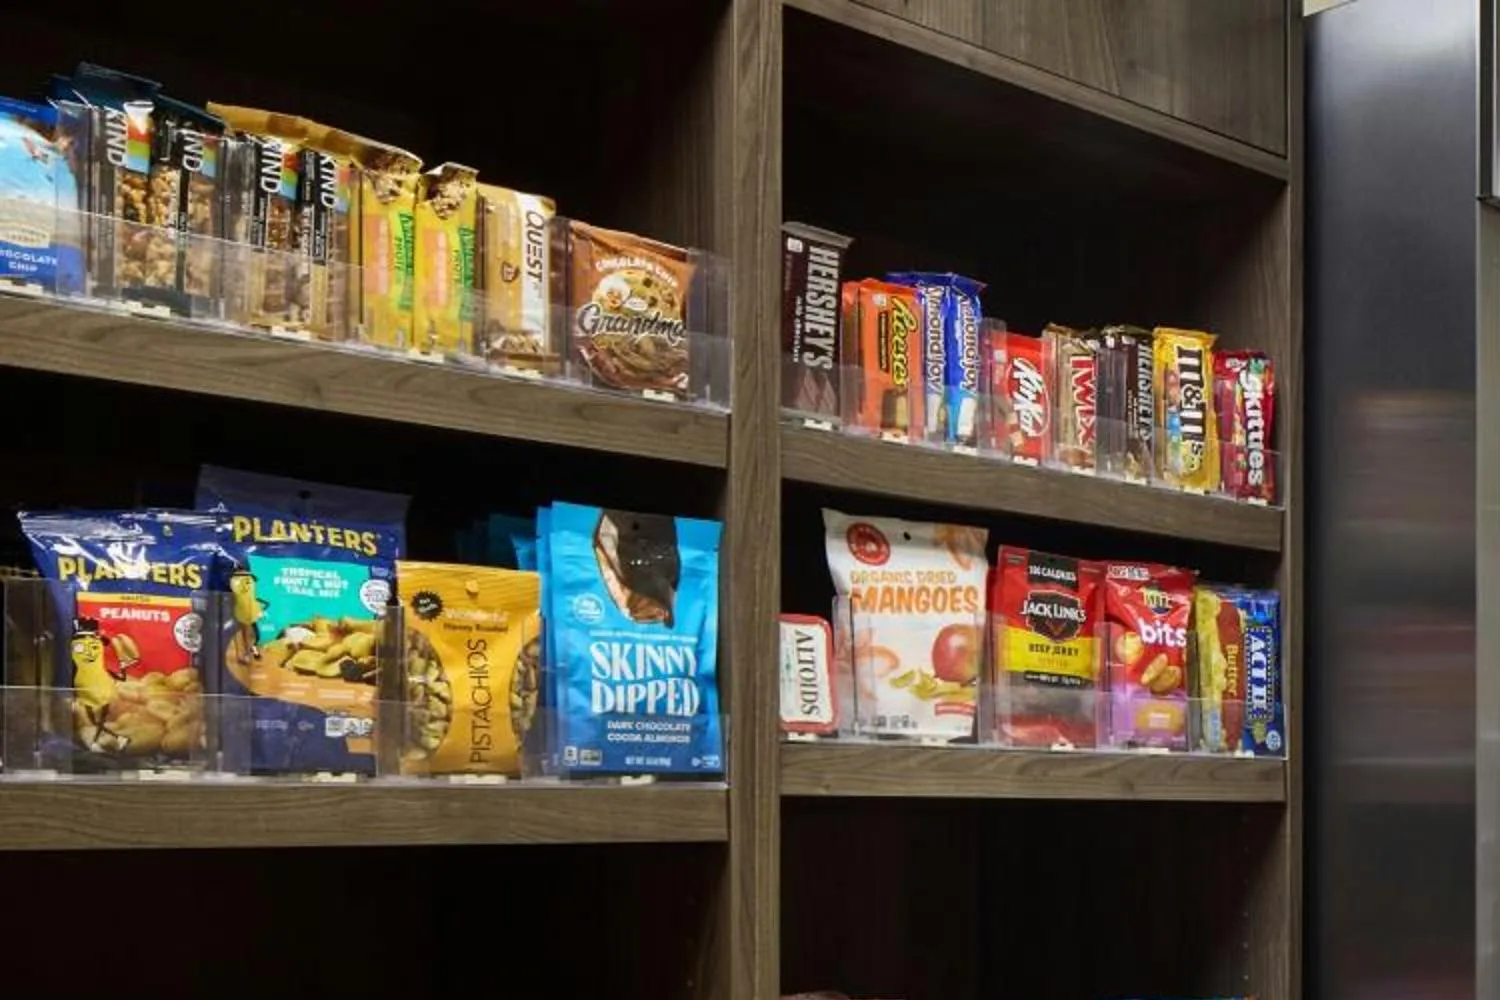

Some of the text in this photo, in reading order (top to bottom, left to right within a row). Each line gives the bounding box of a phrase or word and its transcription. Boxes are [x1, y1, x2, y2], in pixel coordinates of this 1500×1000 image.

[103, 106, 127, 167] KIND
[319, 153, 337, 208] KIND
[526, 210, 546, 283] QUEST
[802, 245, 841, 370] HERSHEY'S
[233, 515, 377, 556] PLANTERS
[99, 607, 170, 622] PEANUTS
[851, 586, 979, 614] MANGOES
[1020, 600, 1052, 618] JACK
[1137, 618, 1187, 648] bits
[590, 641, 698, 681] SKINNY
[794, 629, 820, 718] ALTOIDS
[466, 638, 493, 764] PISTACHIOS
